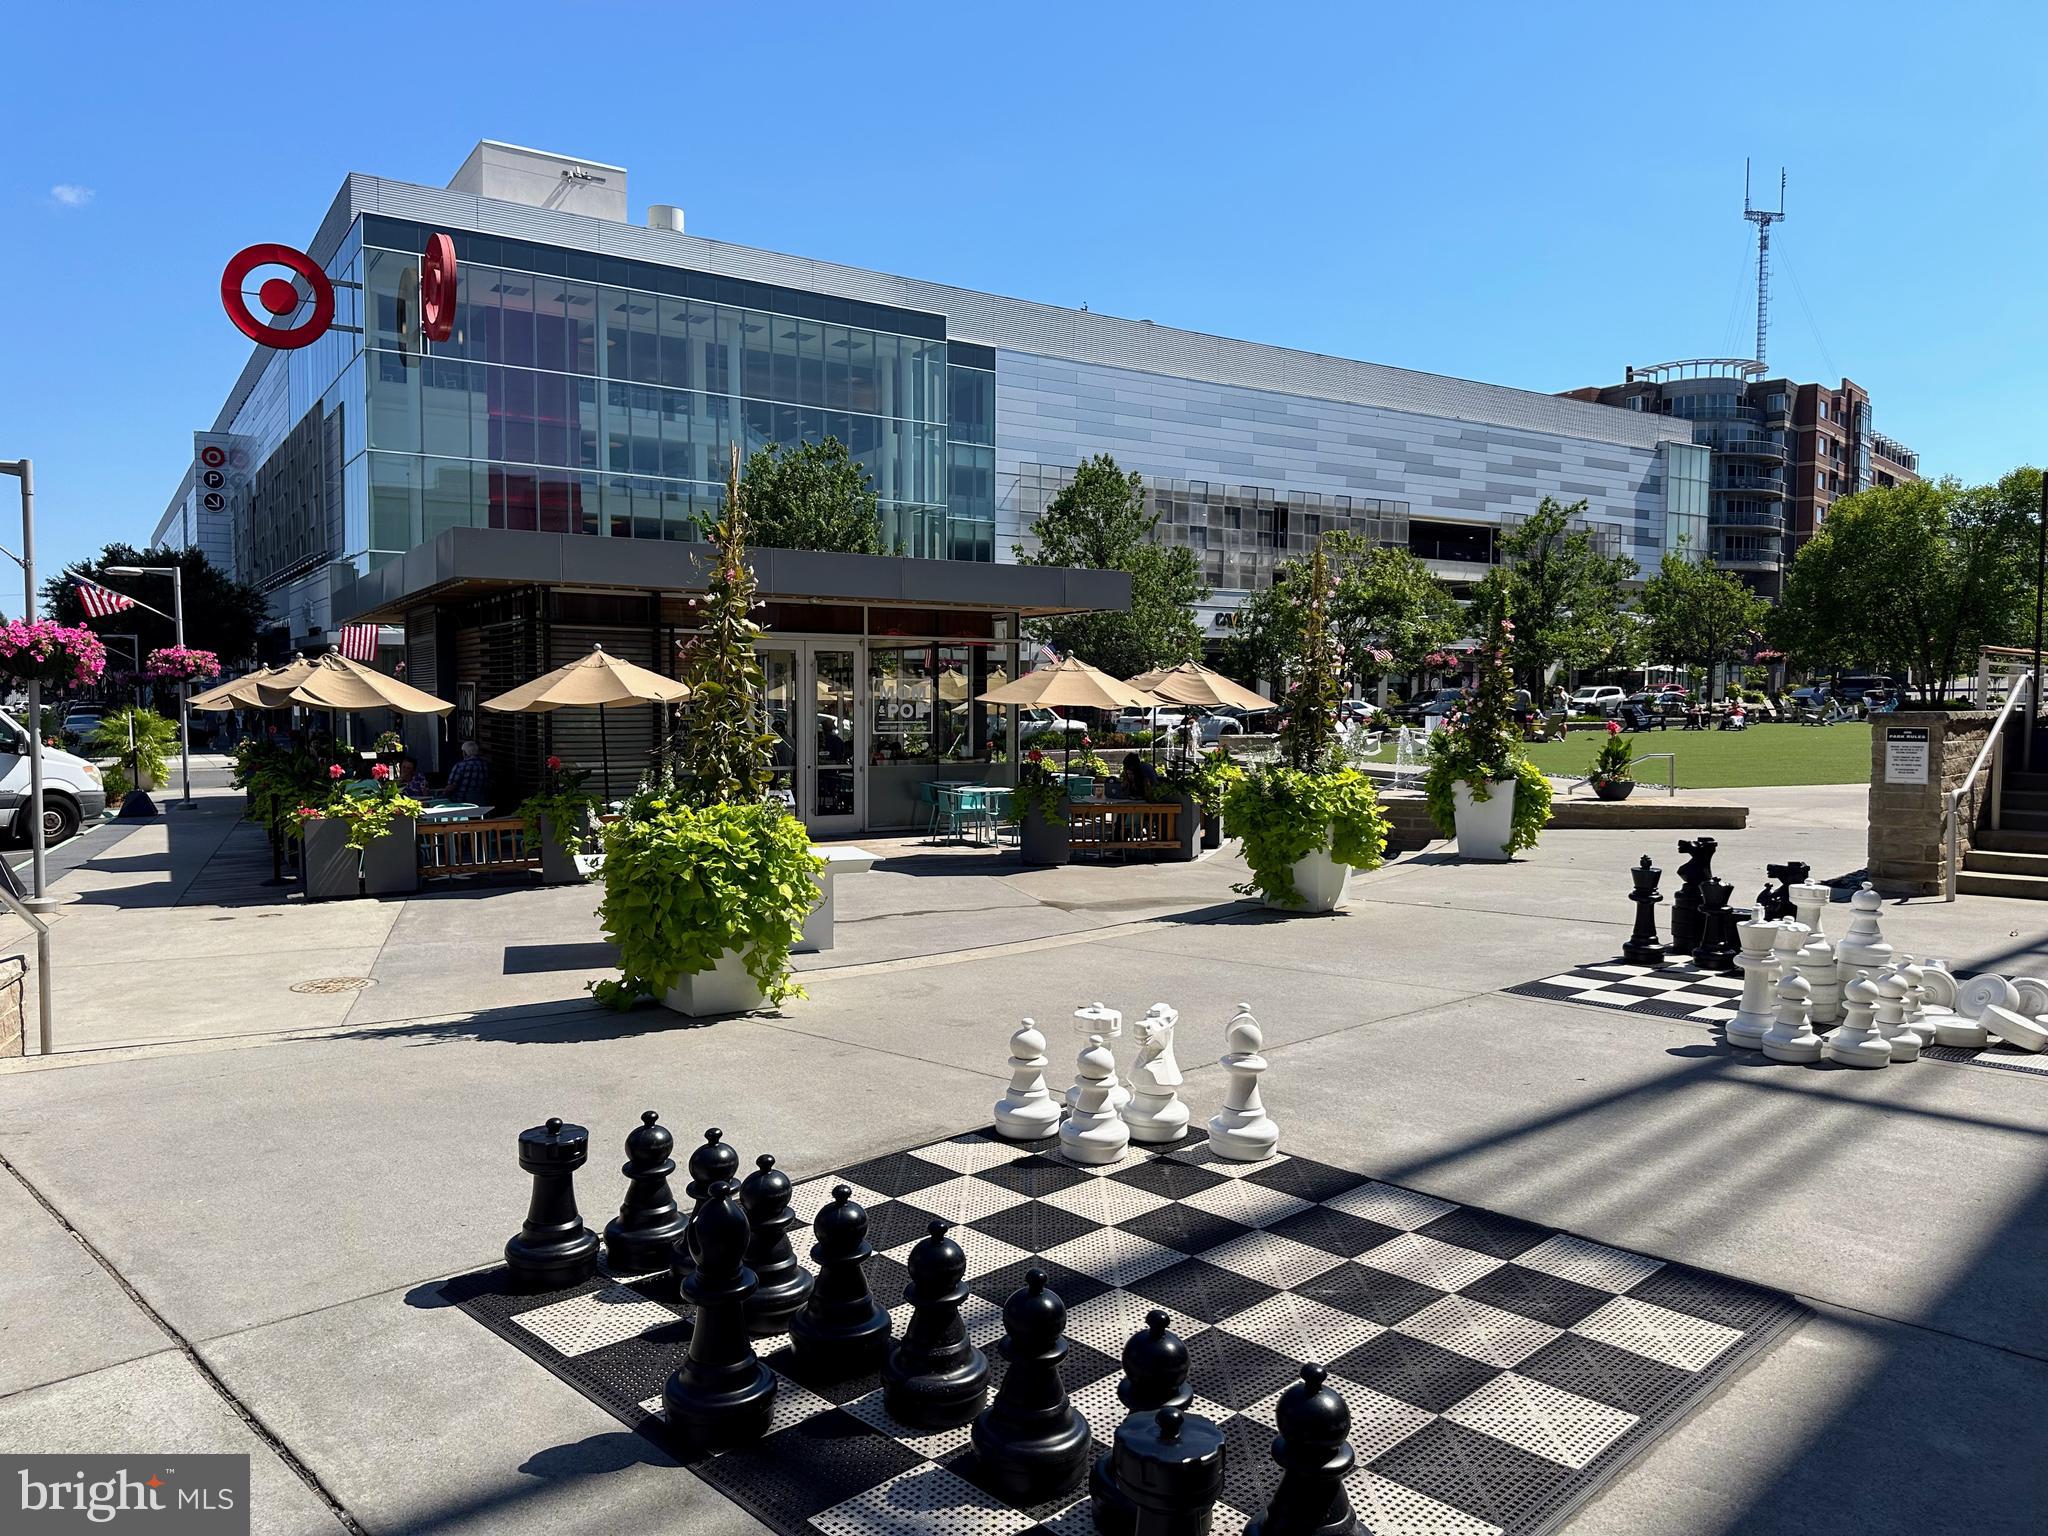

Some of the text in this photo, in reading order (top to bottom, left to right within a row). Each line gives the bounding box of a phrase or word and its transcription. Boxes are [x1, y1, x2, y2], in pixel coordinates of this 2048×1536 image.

[210, 474, 219, 485] P
[880, 685, 926, 699] MOM
[887, 703, 929, 718] POP
